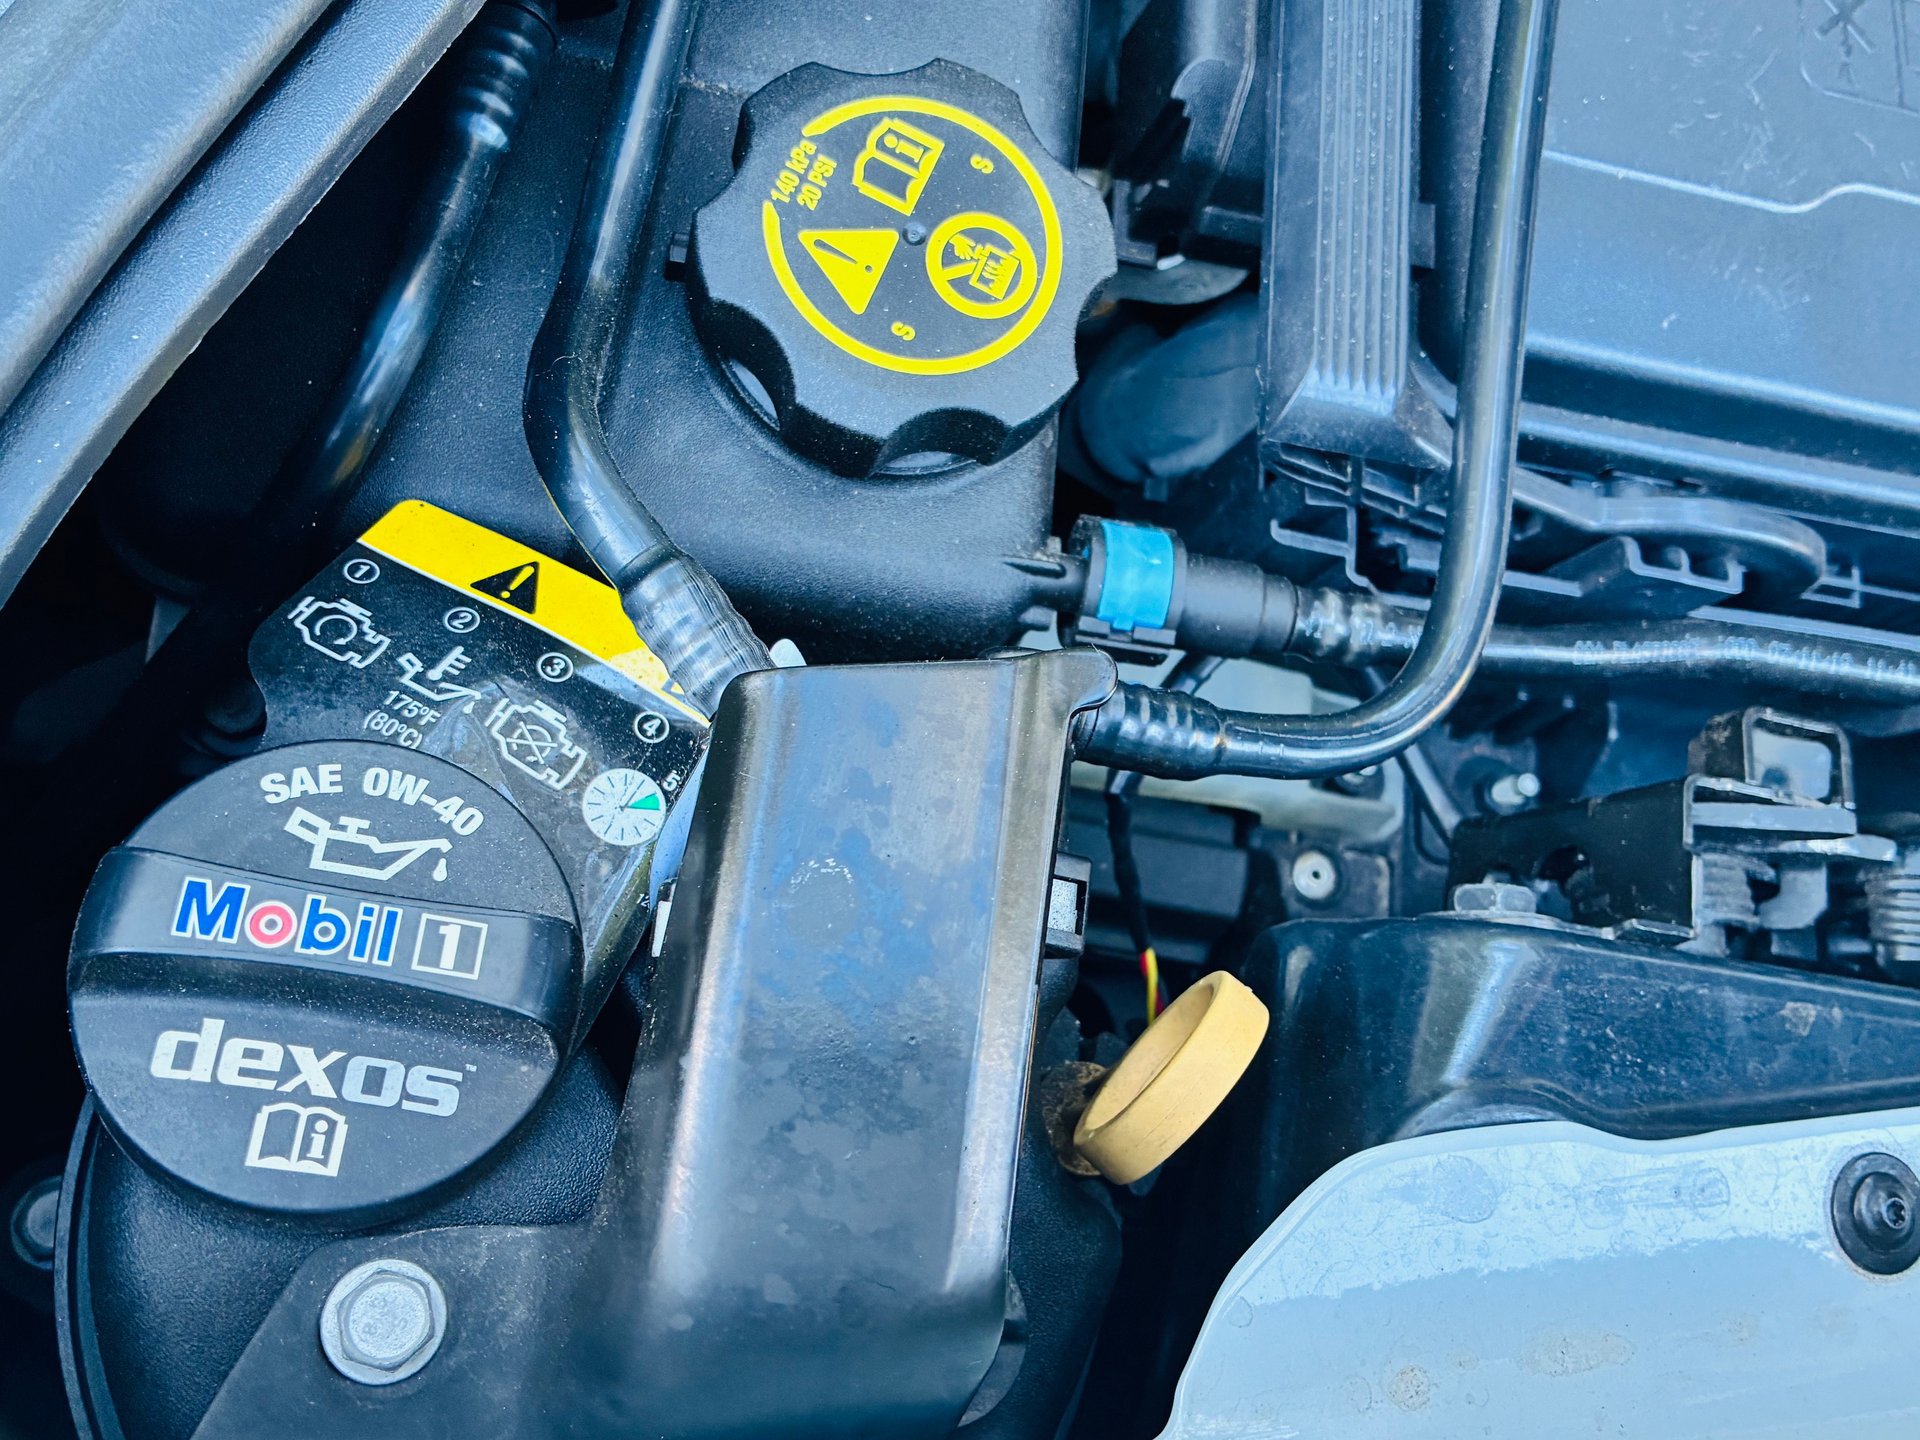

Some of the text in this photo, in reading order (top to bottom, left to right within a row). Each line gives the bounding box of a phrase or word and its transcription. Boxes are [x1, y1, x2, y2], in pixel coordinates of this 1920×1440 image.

[770, 171, 800, 204] 140
[796, 153, 838, 211] 20 PSI
[260, 763, 484, 836] SAE 0W-40
[171, 876, 402, 966] Mobil
